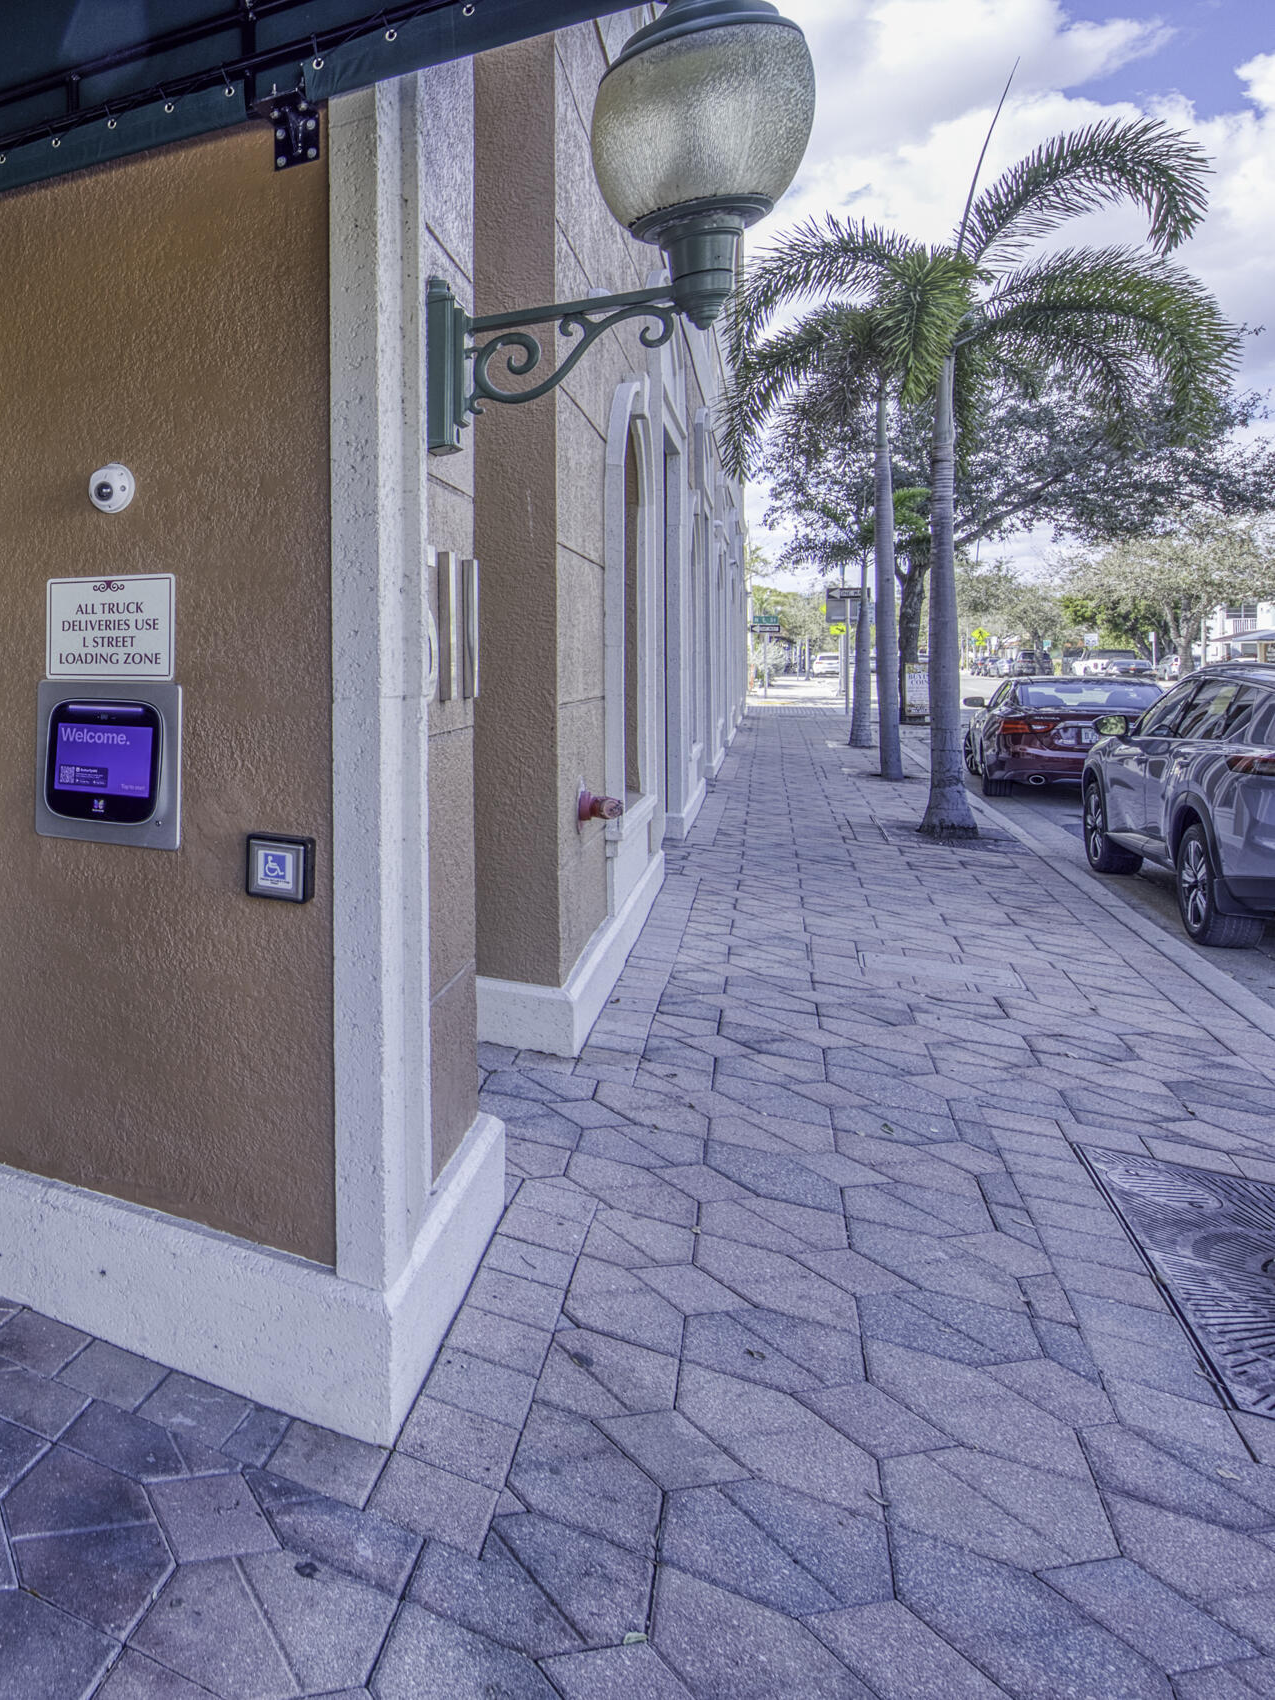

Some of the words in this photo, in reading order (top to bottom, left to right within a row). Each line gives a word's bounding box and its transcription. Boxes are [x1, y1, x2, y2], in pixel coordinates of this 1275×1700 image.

[75, 603, 97, 615] ALL
[100, 602, 144, 614] TRUCK
[61, 619, 130, 632] DELIVERIES
[135, 618, 159, 631] USE
[83, 636, 89, 648] L
[92, 636, 136, 648] STREET
[59, 652, 119, 665] LOADING
[123, 652, 162, 665] ZONE
[61, 727, 130, 745] Welcome.
